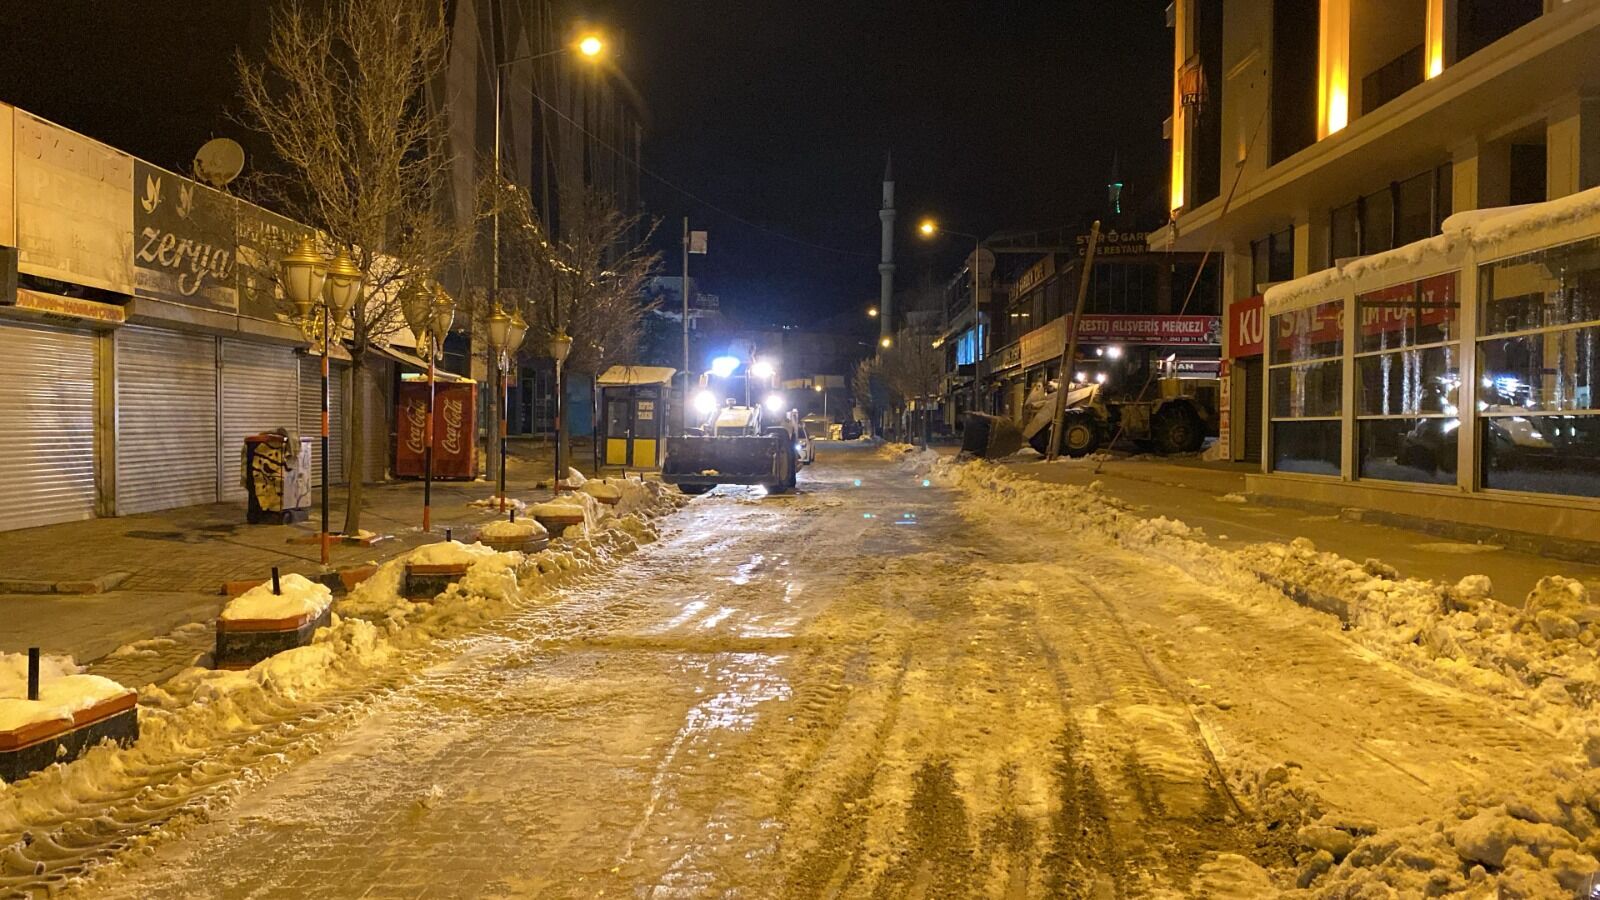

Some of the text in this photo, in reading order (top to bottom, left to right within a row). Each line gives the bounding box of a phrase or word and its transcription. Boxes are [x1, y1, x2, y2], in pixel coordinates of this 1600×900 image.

[1076, 232, 1105, 245] STR
[1079, 318, 1204, 335] RESTİJ ALIŞVERİŞ MERKEZİ
